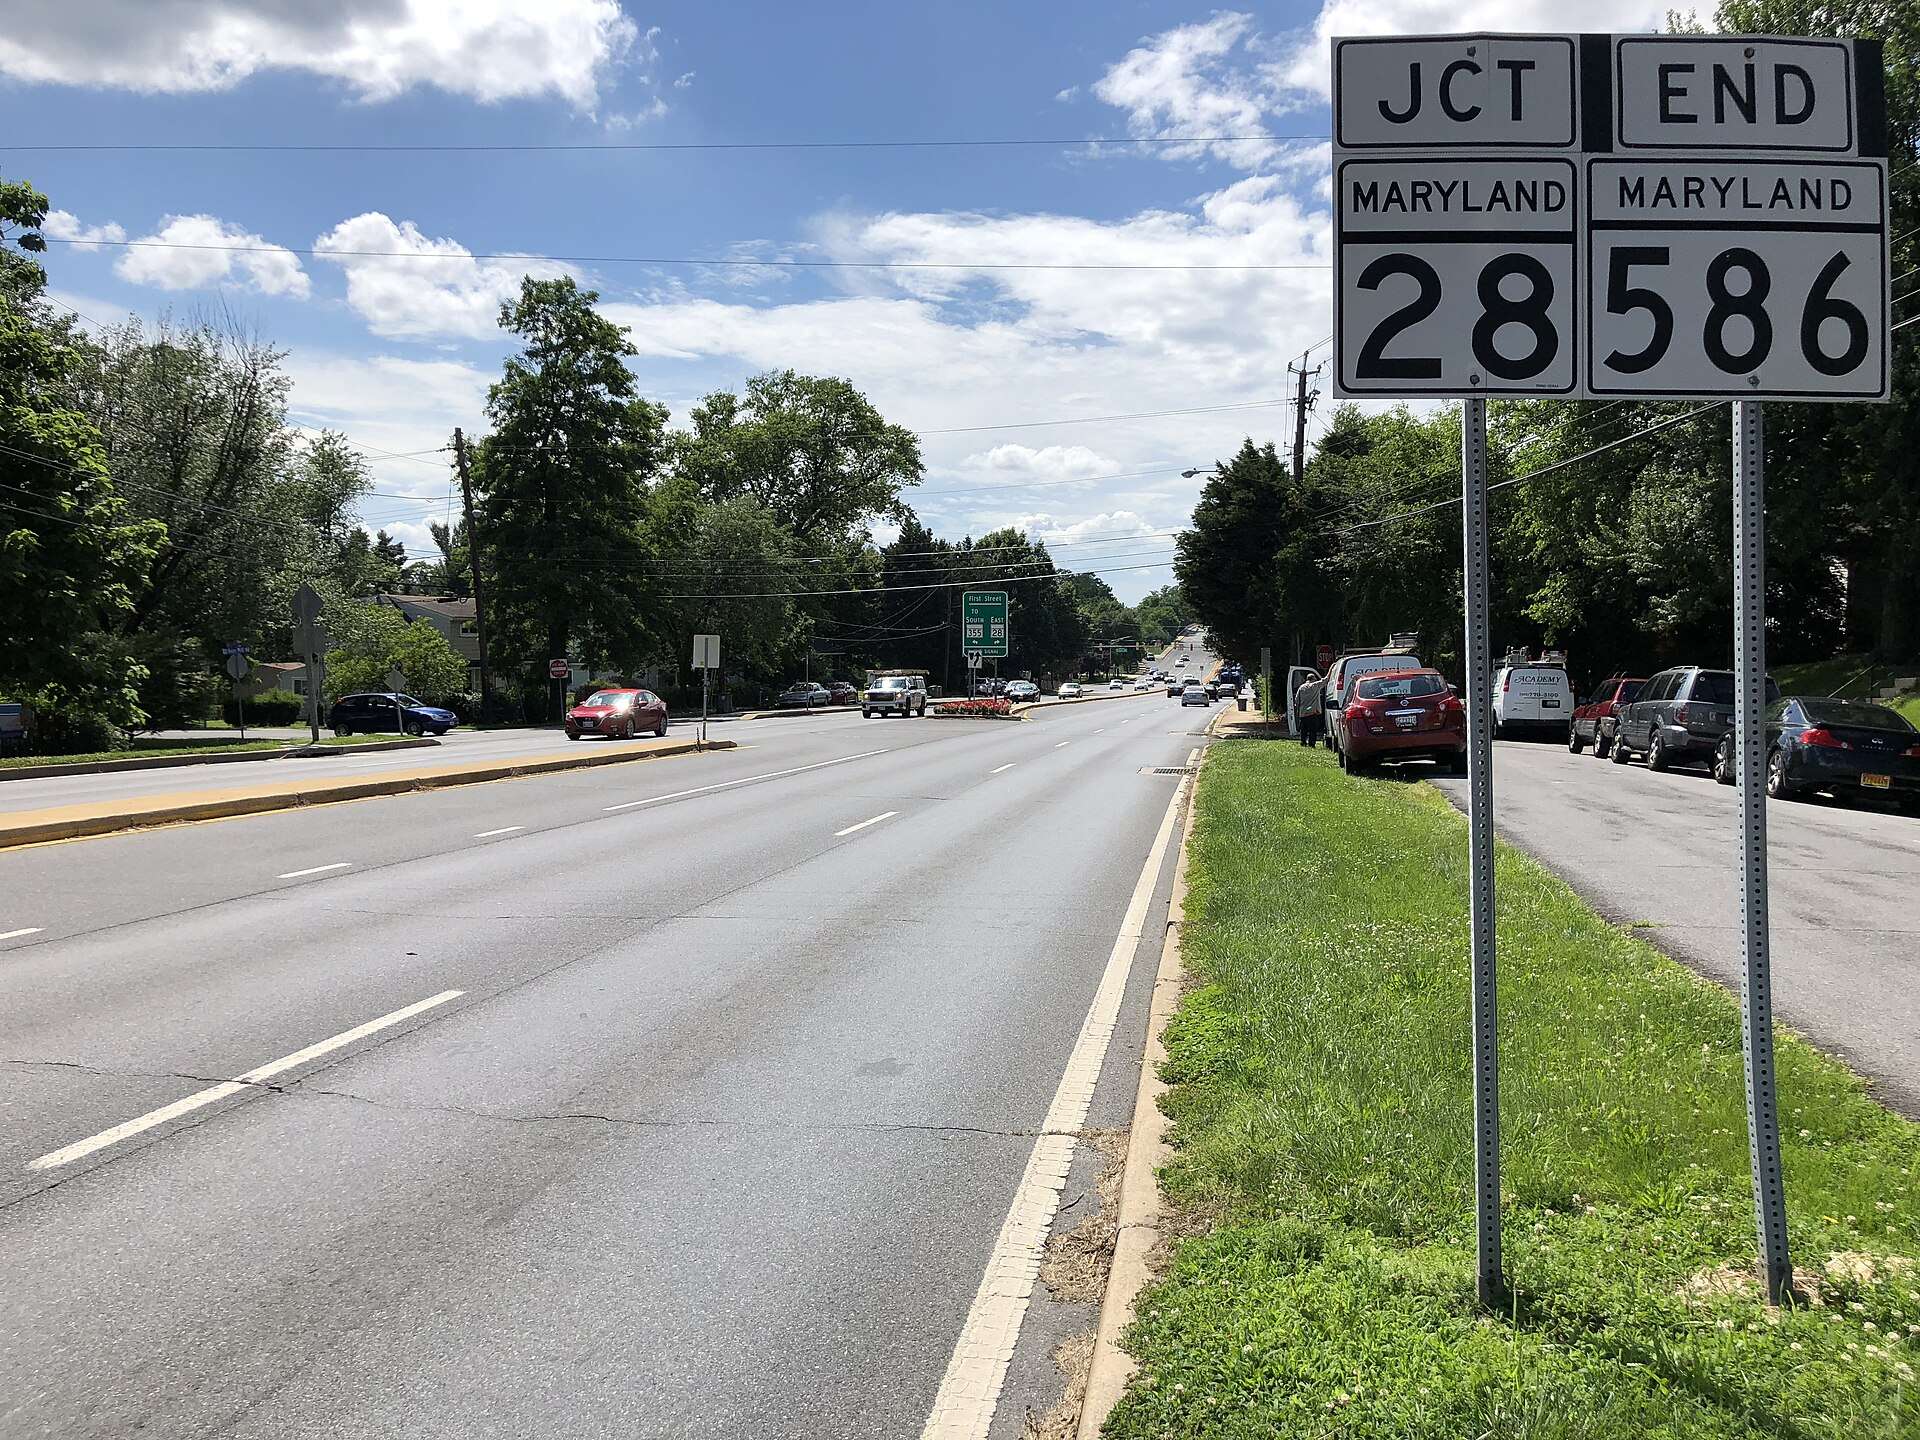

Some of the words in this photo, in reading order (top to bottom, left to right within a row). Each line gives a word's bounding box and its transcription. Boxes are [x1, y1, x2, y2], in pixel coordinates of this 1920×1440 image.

[1378, 59, 1536, 123] JCT
[1658, 62, 1816, 125] END
[1352, 179, 1567, 213] MARYLAND
[1618, 175, 1853, 211] MARYLAND
[1355, 252, 1559, 381] 28
[1603, 246, 1869, 377] 586
[968, 628, 982, 636] 355
[992, 628, 1002, 636] 28
